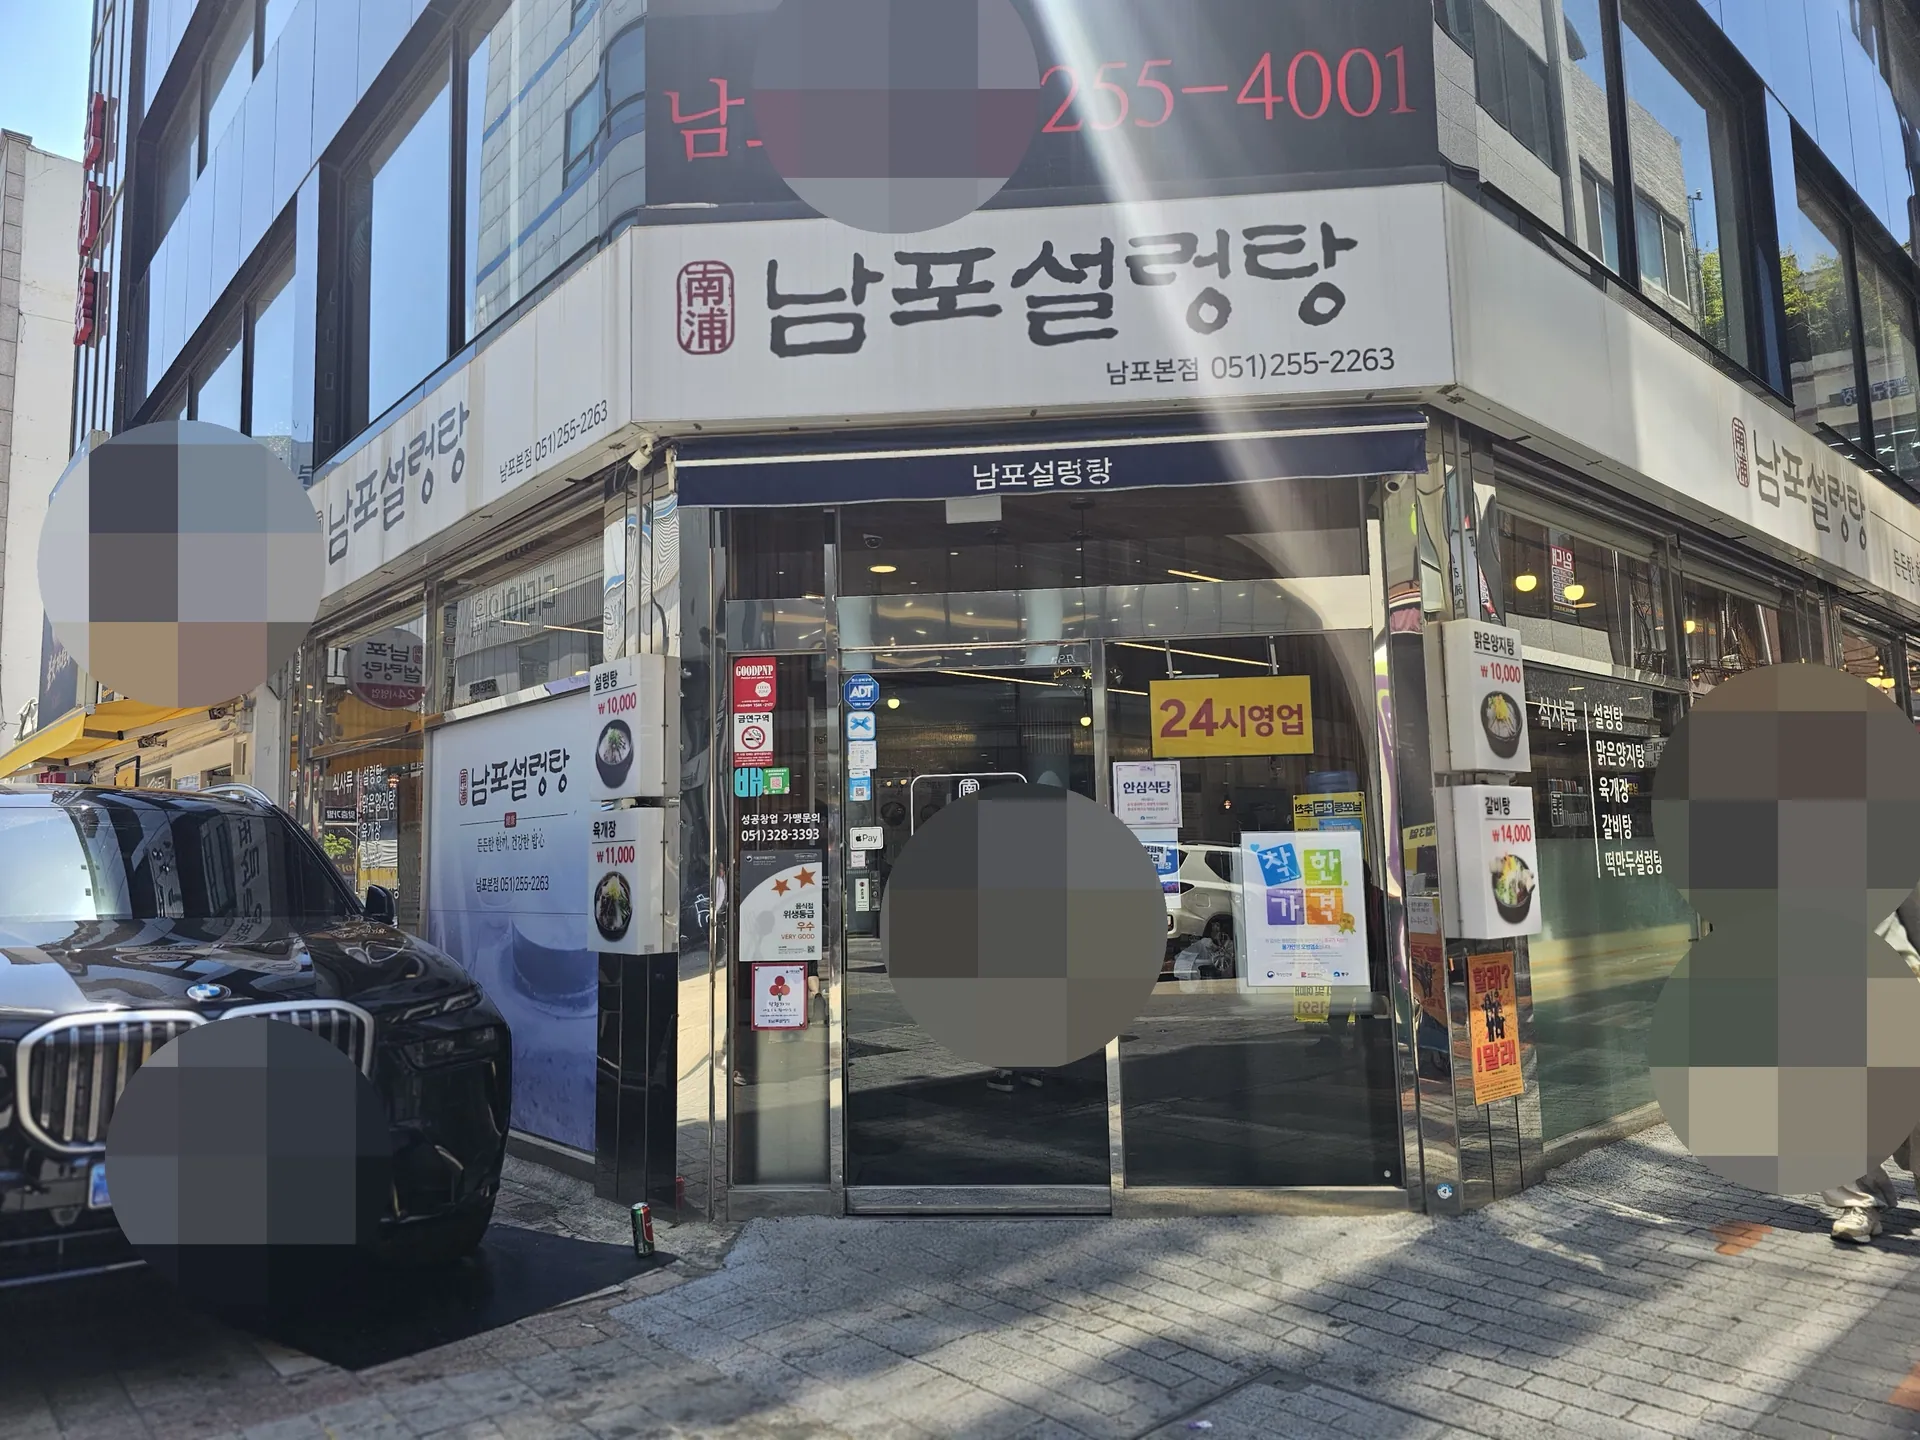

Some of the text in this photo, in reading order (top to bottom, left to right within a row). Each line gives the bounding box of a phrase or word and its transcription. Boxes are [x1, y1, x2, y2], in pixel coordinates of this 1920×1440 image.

[664, 77, 763, 162] 남
[766, 221, 1358, 358] 남포설렁탕
[681, 263, 730, 354] 南浦
[1107, 347, 1395, 385] 남포본점 051)255-2263
[499, 399, 608, 484] 남포본점 051)255-2263
[328, 401, 470, 566] 남포설렁탕
[973, 457, 1112, 490] 남포설렁탕
[1754, 430, 1866, 550] 남포설렁탕
[1894, 549, 1915, 585] 든든한
[1473, 631, 1515, 656] 맑은양지탕
[594, 670, 618, 691] 설렁탕
[736, 665, 773, 677] GOODPNP
[850, 685, 873, 698] ADT
[738, 714, 769, 723] 금연구역
[1159, 698, 1304, 738] 24시영업
[1538, 696, 1577, 732] 식사류
[1593, 703, 1623, 731] 설렁탕
[1596, 739, 1645, 768] 맑은양지탕
[333, 771, 353, 795] 식사류
[471, 748, 570, 806] 남포설렁탕
[1123, 781, 1171, 794] 안심식당
[1598, 776, 1629, 803] 육개장
[741, 812, 820, 825] 성공창업 가맹문의
[1484, 796, 1511, 816] 갈비탕
[593, 820, 617, 839] 육개장
[741, 828, 820, 842] 051)328-3393
[862, 834, 878, 843] Pay
[1602, 813, 1632, 840] 갈비탕
[477, 836, 494, 852] 든든한
[1605, 849, 1663, 876] 떡만두설렁탕
[476, 875, 549, 892] 남포본점 051)255-2263
[783, 910, 815, 919] 위생등급
[797, 922, 815, 931] 우수
